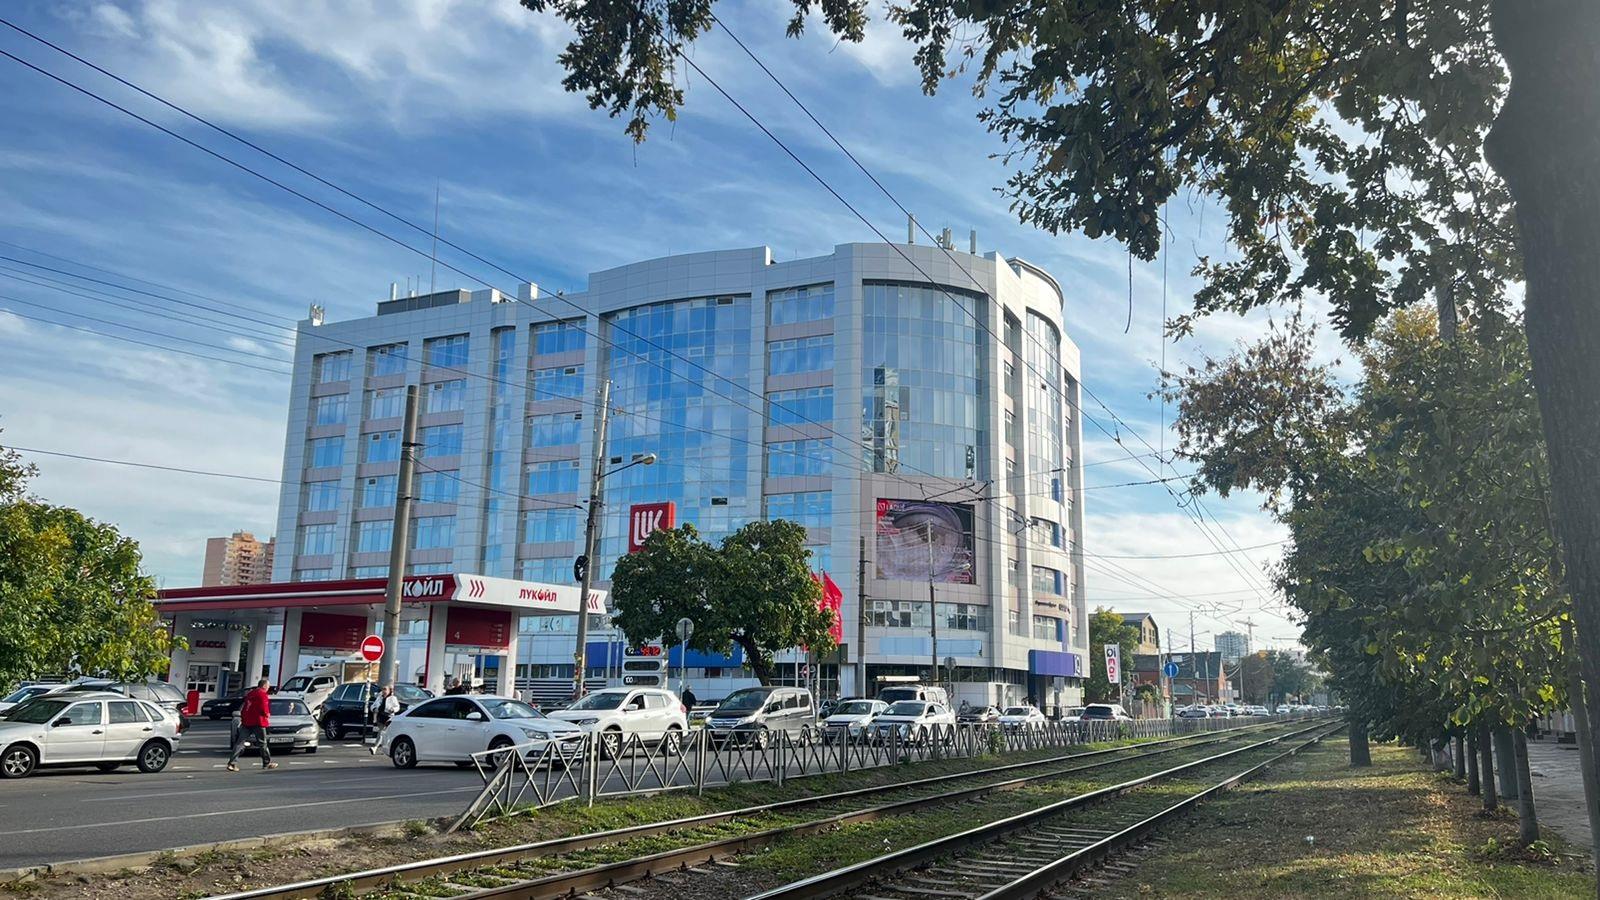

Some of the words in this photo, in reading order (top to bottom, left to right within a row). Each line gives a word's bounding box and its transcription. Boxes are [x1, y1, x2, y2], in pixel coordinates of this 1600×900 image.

[519, 589, 557, 602] ЛУКОЙЛ
[308, 634, 314, 642] 2
[454, 631, 460, 639] 4
[195, 640, 226, 648] КАССА
